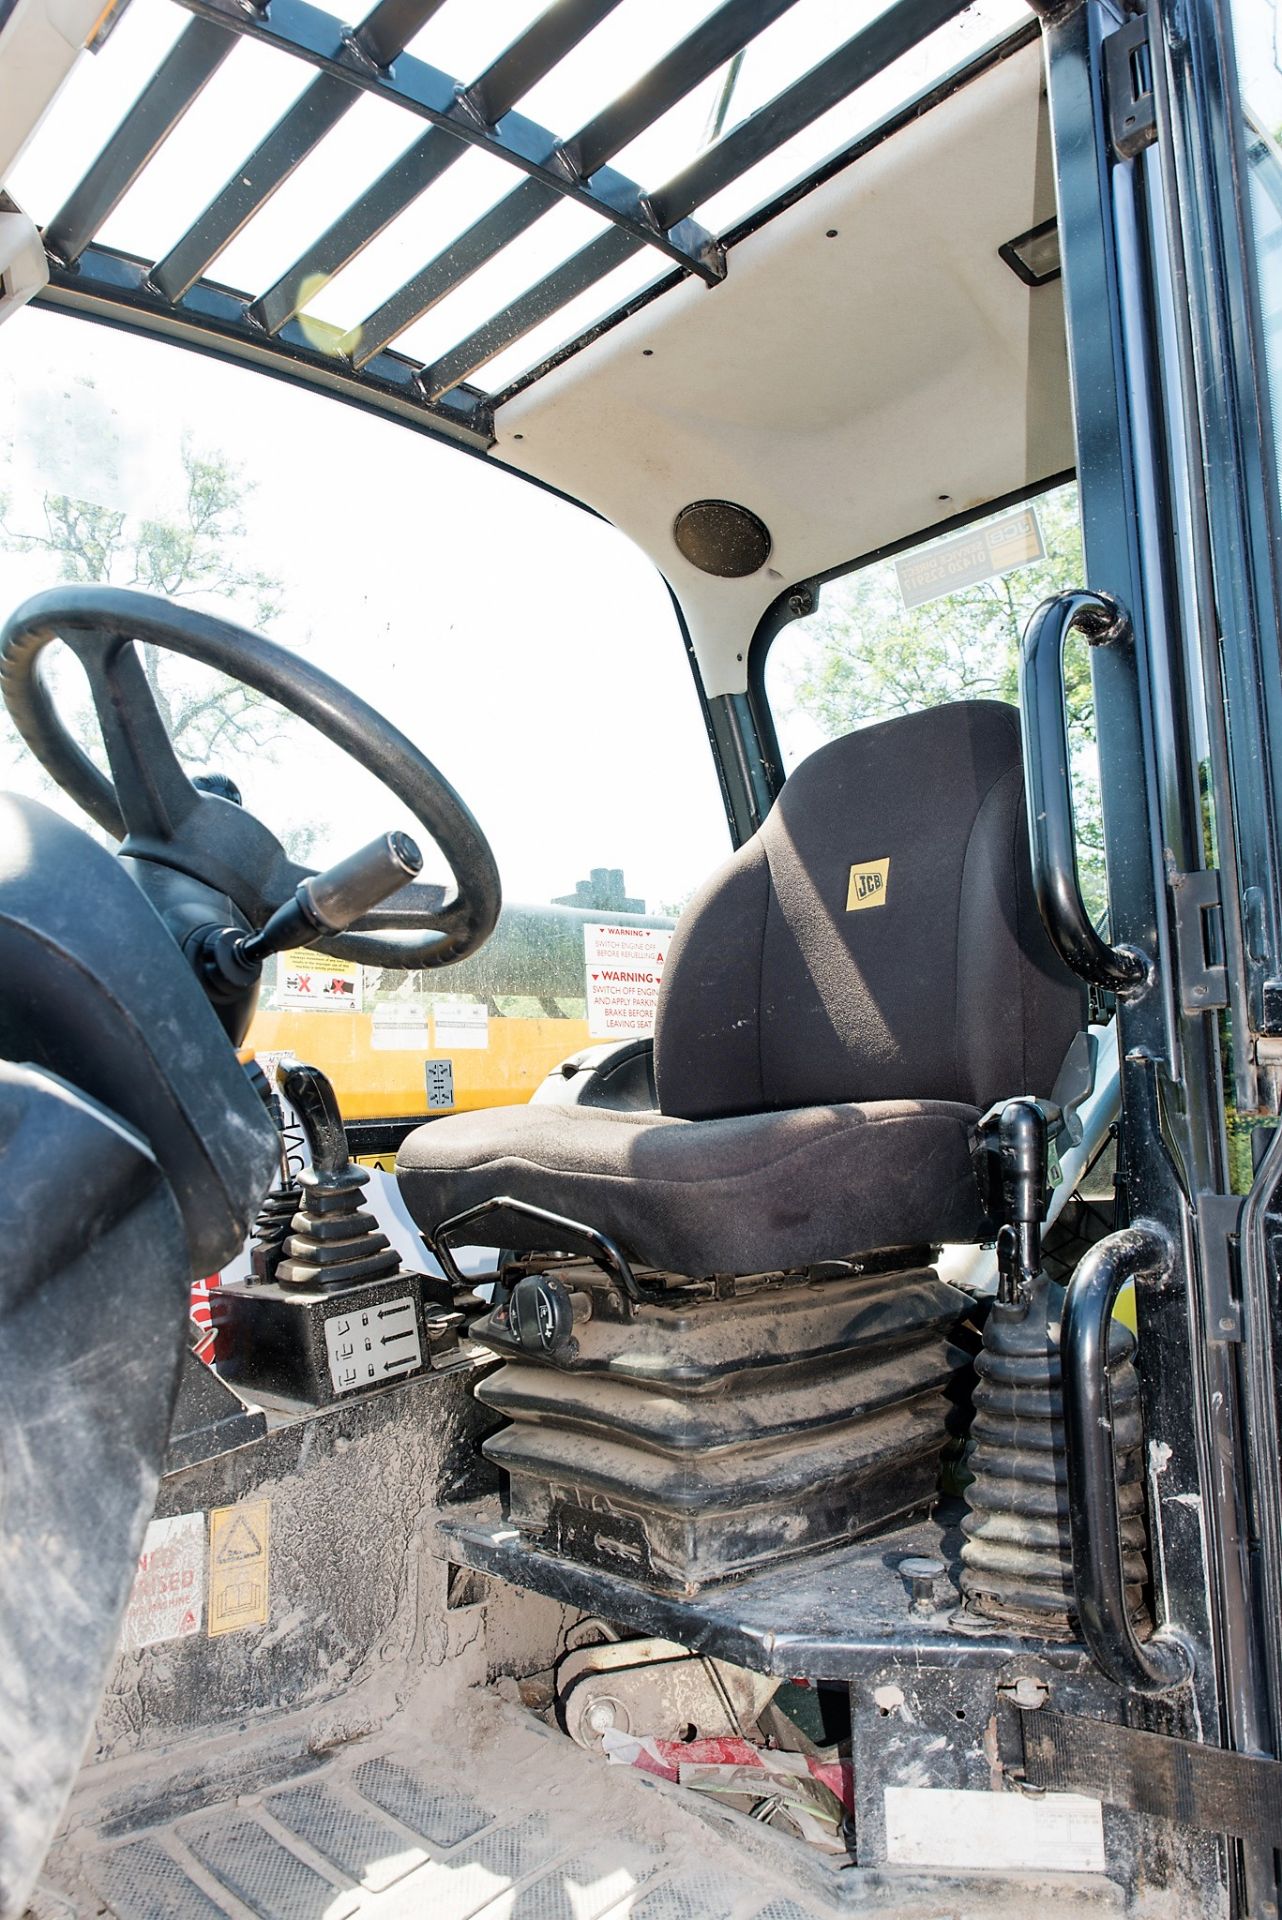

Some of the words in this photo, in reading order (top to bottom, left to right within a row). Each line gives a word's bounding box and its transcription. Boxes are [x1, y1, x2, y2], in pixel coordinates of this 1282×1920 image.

[859, 874, 881, 897] JCB
[608, 928, 643, 937] WARNING
[595, 940, 620, 949] SWITCH
[601, 971, 654, 984] WARNING
[593, 985, 621, 995] SWITCH
[622, 987, 636, 995] OFF
[637, 987, 659, 997] ENGIN
[594, 996, 611, 1006] AND
[612, 997, 631, 1006] APPLY
[632, 998, 658, 1007] PARKIN
[604, 1008, 627, 1017] BRAKE
[628, 1009, 654, 1018] BEFORE
[606, 1019, 636, 1029] LEAVING
[637, 1020, 653, 1029] SEAT
